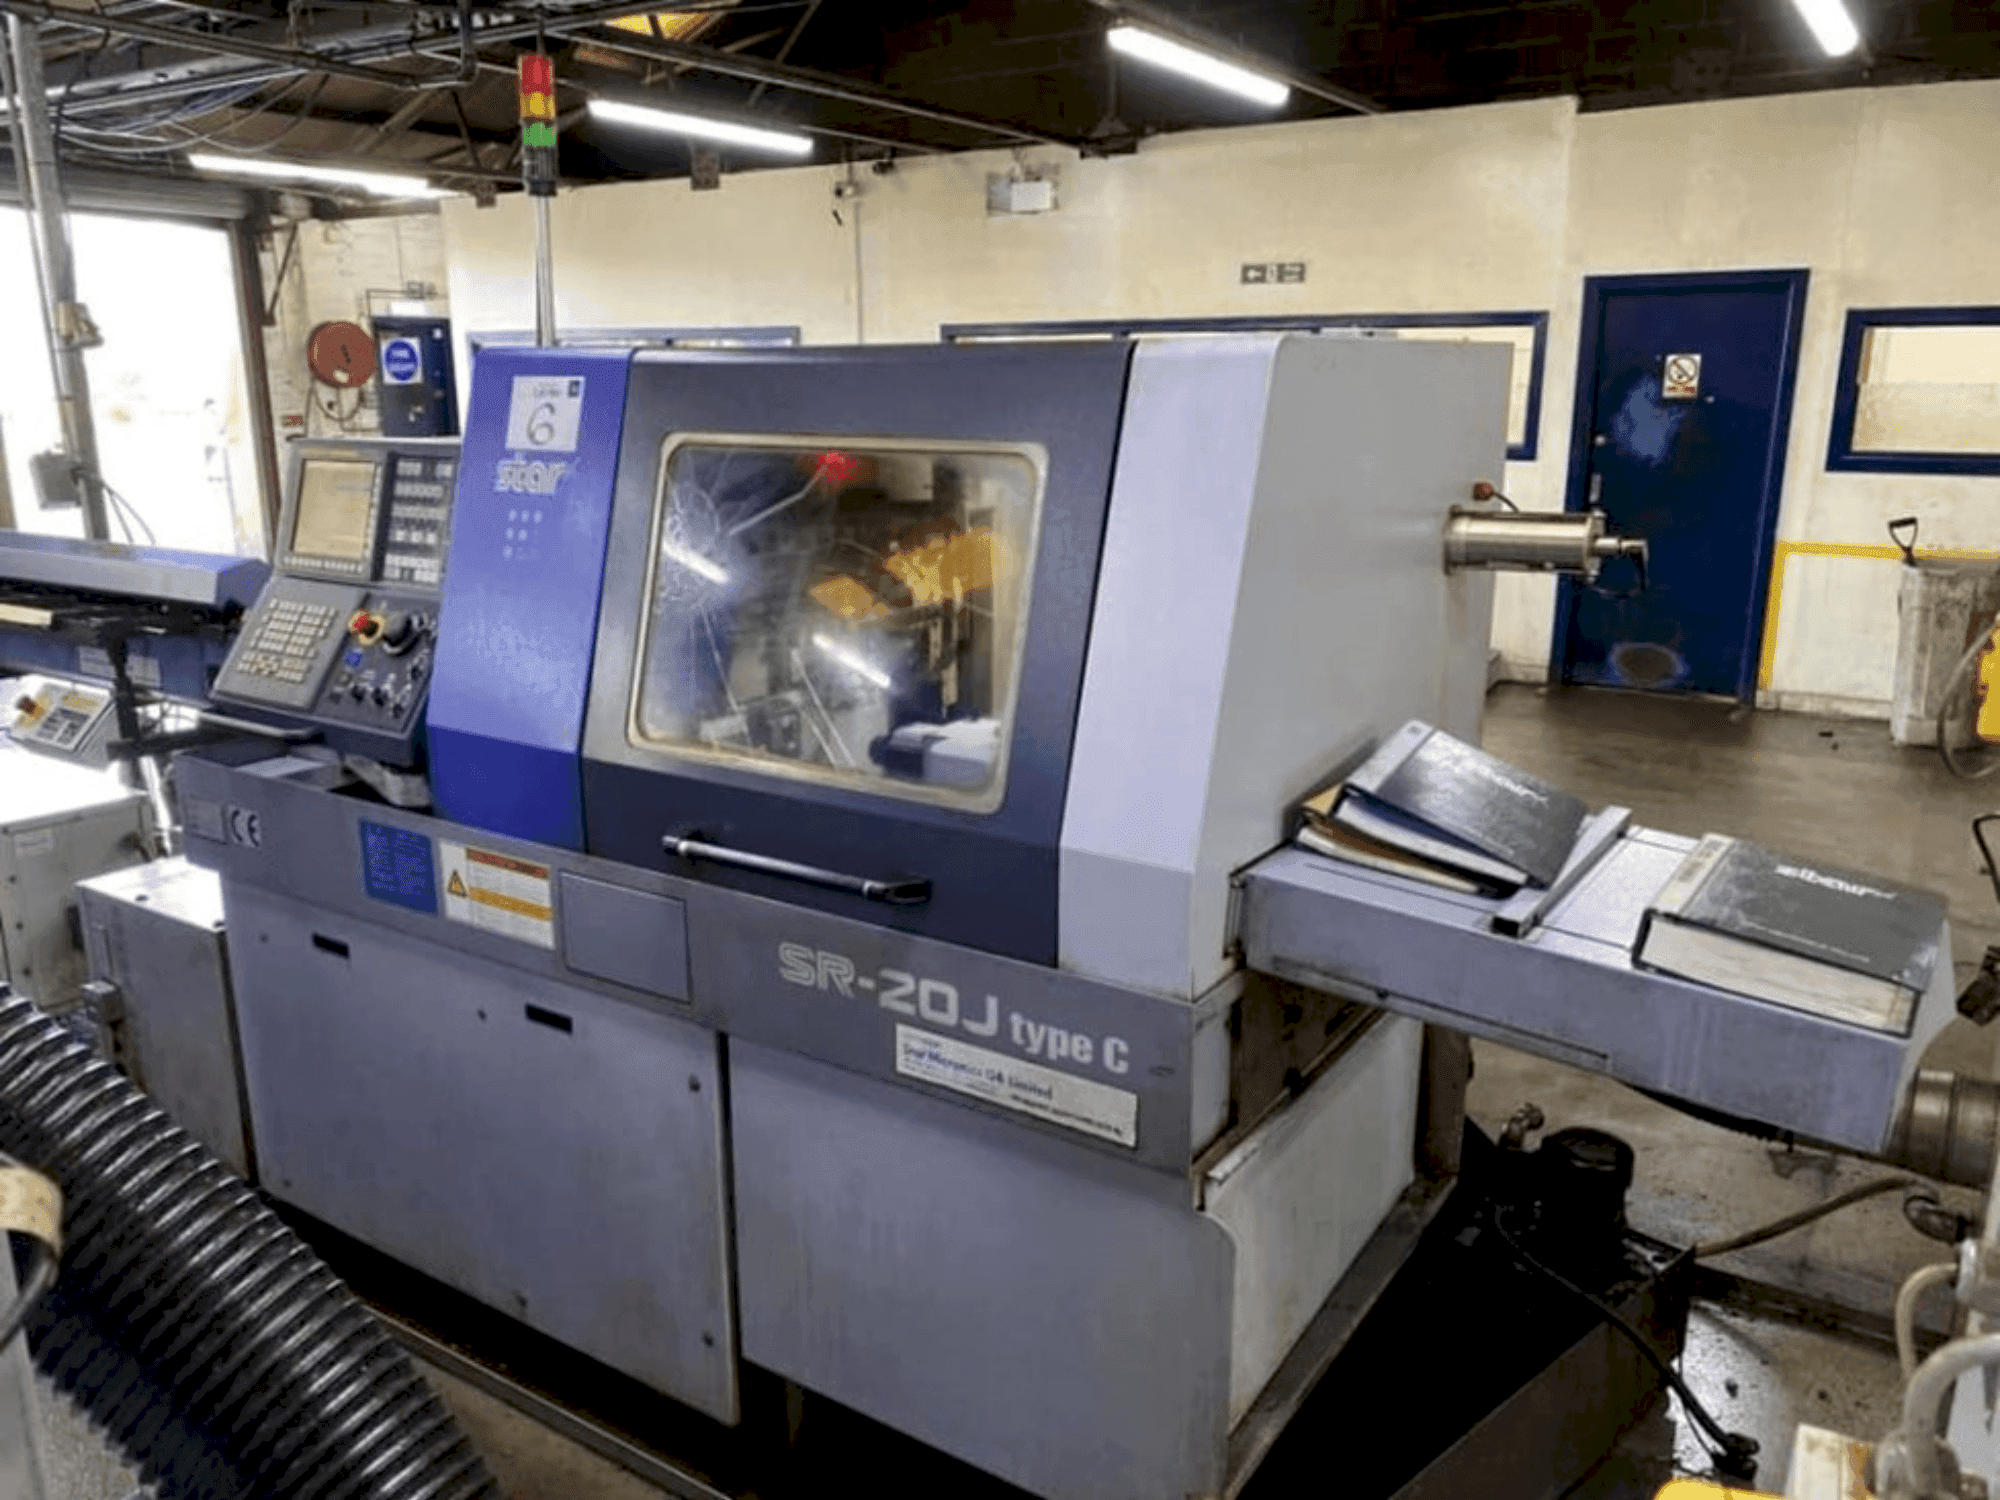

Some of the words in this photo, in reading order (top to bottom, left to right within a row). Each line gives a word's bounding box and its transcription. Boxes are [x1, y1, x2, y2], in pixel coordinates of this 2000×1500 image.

[526, 402, 556, 446] 6
[230, 809, 259, 847] CE
[1009, 1012, 1093, 1064] type
[1104, 1037, 1130, 1074] C
